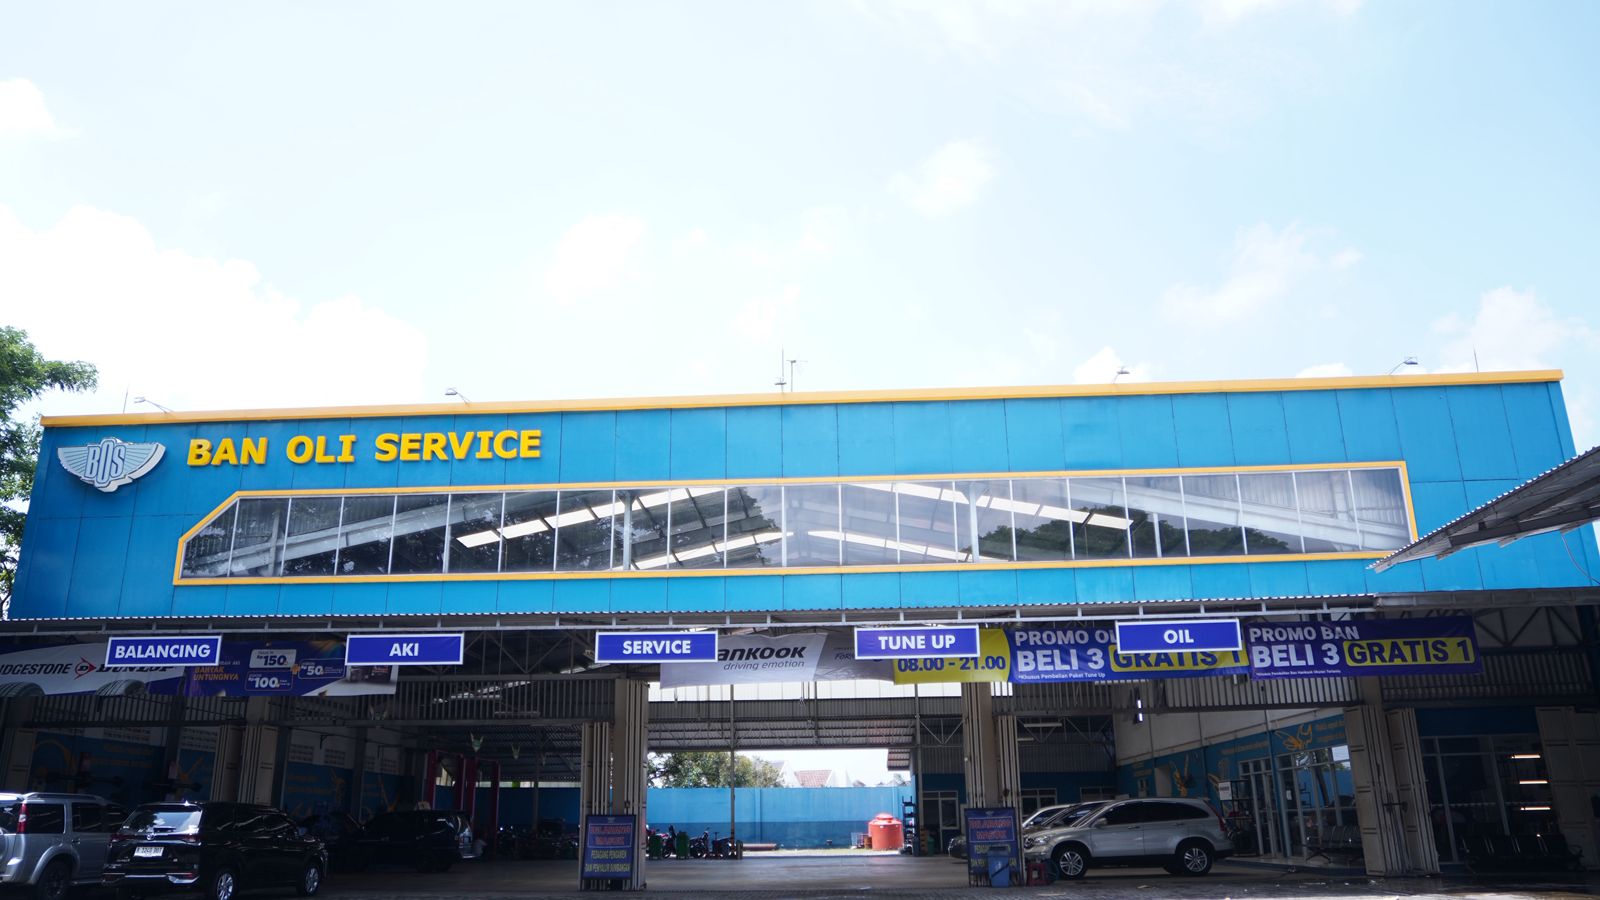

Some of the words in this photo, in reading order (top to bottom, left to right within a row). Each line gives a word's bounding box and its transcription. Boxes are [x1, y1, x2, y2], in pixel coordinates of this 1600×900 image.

[187, 437, 268, 467] BAN
[286, 434, 357, 464] OLI
[375, 430, 542, 462] SERVICE
[84, 440, 126, 484] BOS
[878, 635, 926, 650] TUNE
[931, 634, 956, 649] UP
[1015, 630, 1089, 647] PROMO
[1163, 629, 1194, 644] OIL
[1249, 626, 1317, 643] PROMO
[1321, 625, 1360, 641] BAN
[114, 644, 211, 659] BALANCING
[389, 642, 419, 657] AKI
[622, 639, 691, 655] SERVICE
[718, 646, 807, 662] ankook
[1251, 643, 1315, 668] BELI
[1321, 642, 1341, 666] 3
[1347, 639, 1449, 665] GRATIS
[1456, 639, 1471, 662] 1
[723, 661, 758, 672] driving
[761, 660, 805, 669] emotion
[897, 658, 944, 672] 08.00
[959, 656, 1006, 671] 21.00
[1017, 648, 1079, 672] BELI
[1088, 647, 1105, 670] 3
[1113, 650, 1217, 668] GRATIS
[0, 664, 72, 675] IDGESTONE
